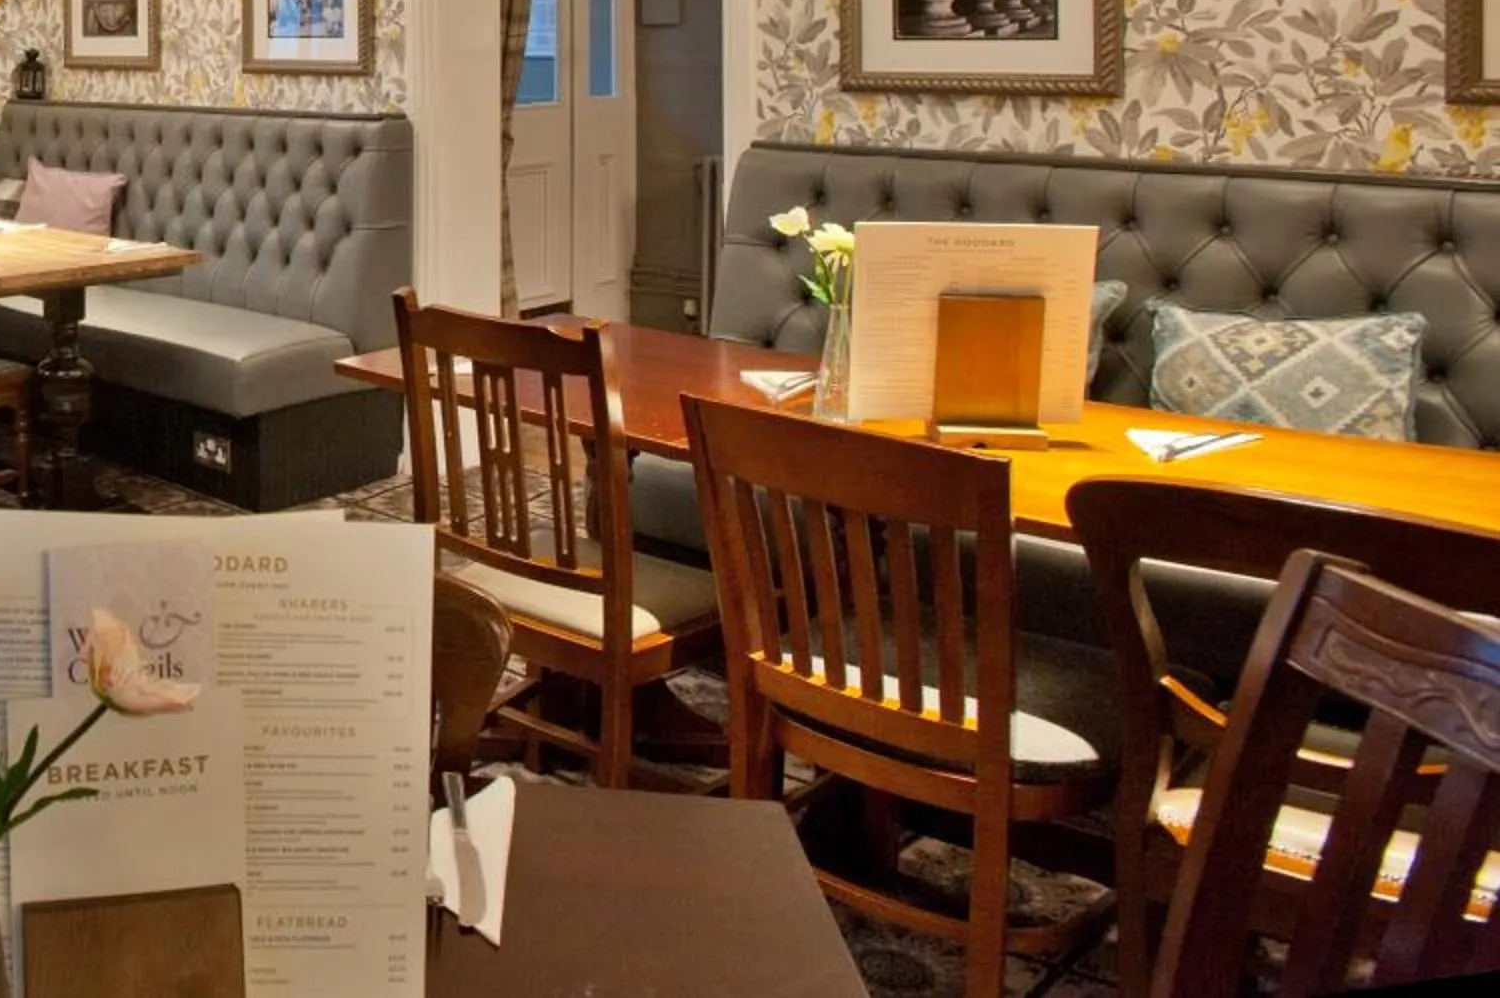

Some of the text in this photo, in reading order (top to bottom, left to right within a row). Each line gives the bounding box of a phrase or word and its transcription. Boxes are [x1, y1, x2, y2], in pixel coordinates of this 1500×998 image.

[278, 599, 349, 611] SHARERS
[262, 726, 357, 738] FAVOURITES
[46, 754, 210, 785] BREAKFAST
[256, 916, 348, 928] FLATBREAD
